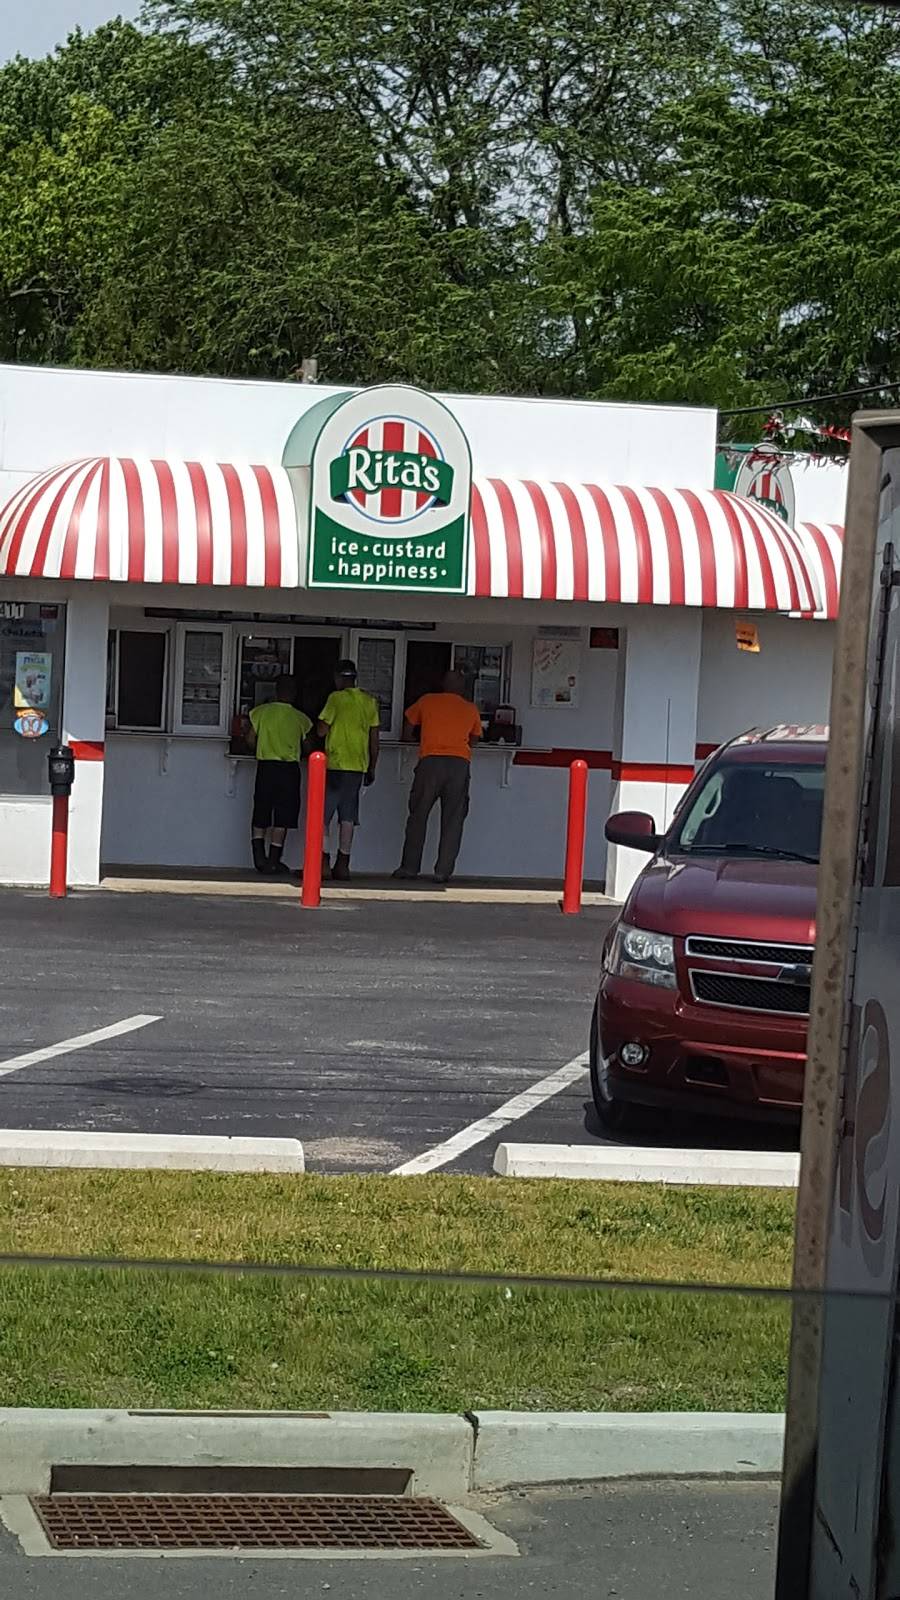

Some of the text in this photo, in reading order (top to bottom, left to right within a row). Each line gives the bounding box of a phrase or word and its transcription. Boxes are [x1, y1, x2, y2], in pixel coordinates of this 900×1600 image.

[347, 449, 441, 492] Rita's
[331, 537, 446, 560] ice custard
[338, 558, 437, 581] happiness
